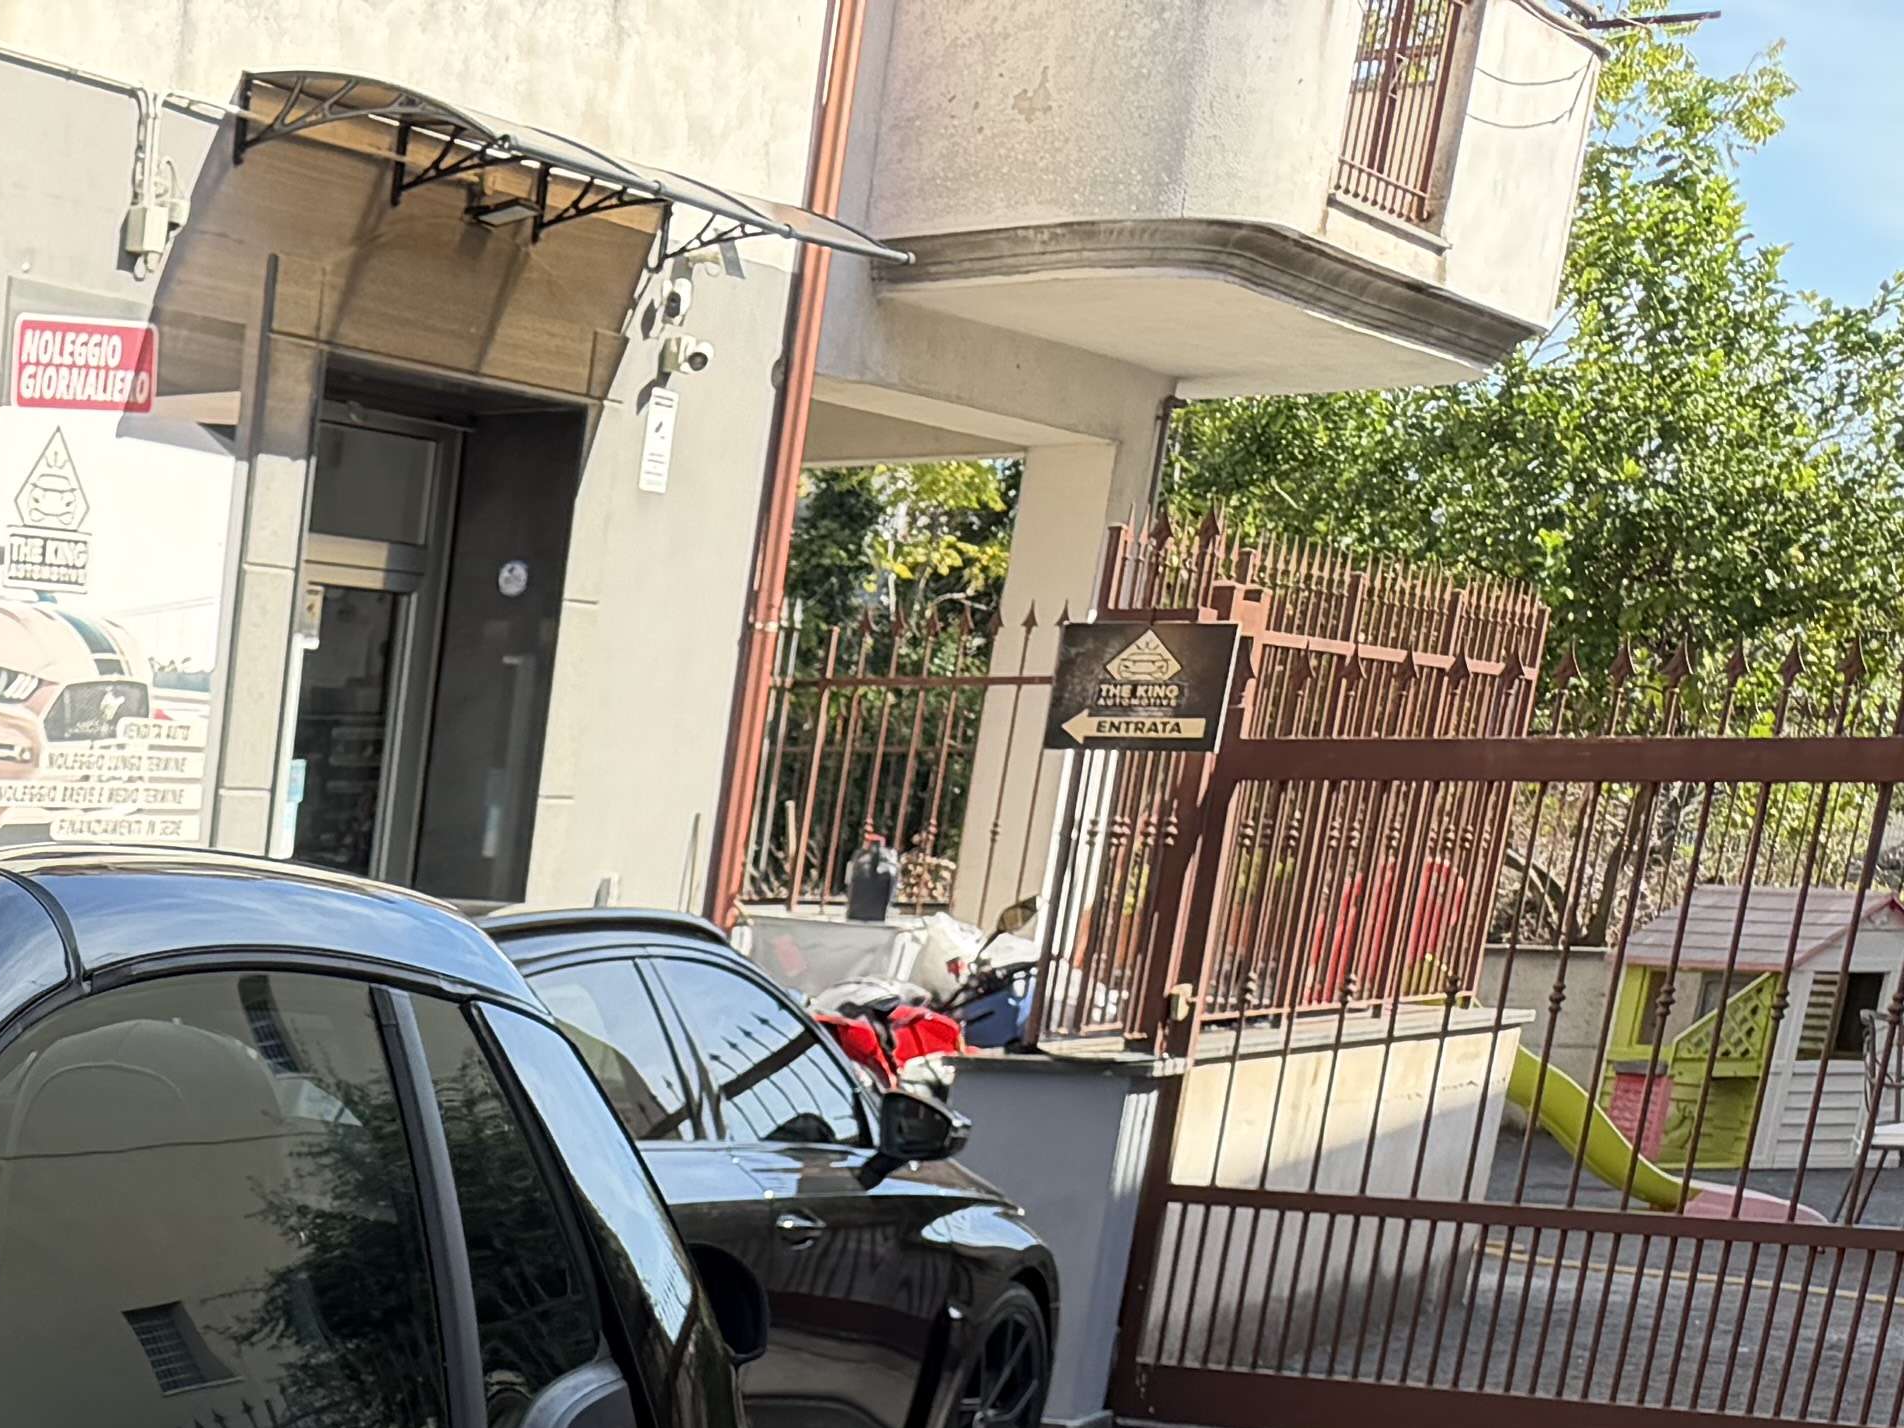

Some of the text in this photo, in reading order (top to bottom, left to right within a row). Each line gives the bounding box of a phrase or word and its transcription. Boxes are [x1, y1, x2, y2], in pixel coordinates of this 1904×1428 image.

[21, 328, 123, 369] NOLEGGIO
[20, 364, 150, 404] GIORNALIERO
[11, 537, 88, 568] THE KING
[1099, 684, 1181, 698] THE KING
[1096, 698, 1177, 707] AUTOMOTIVE
[1096, 720, 1182, 734] ENTRATA
